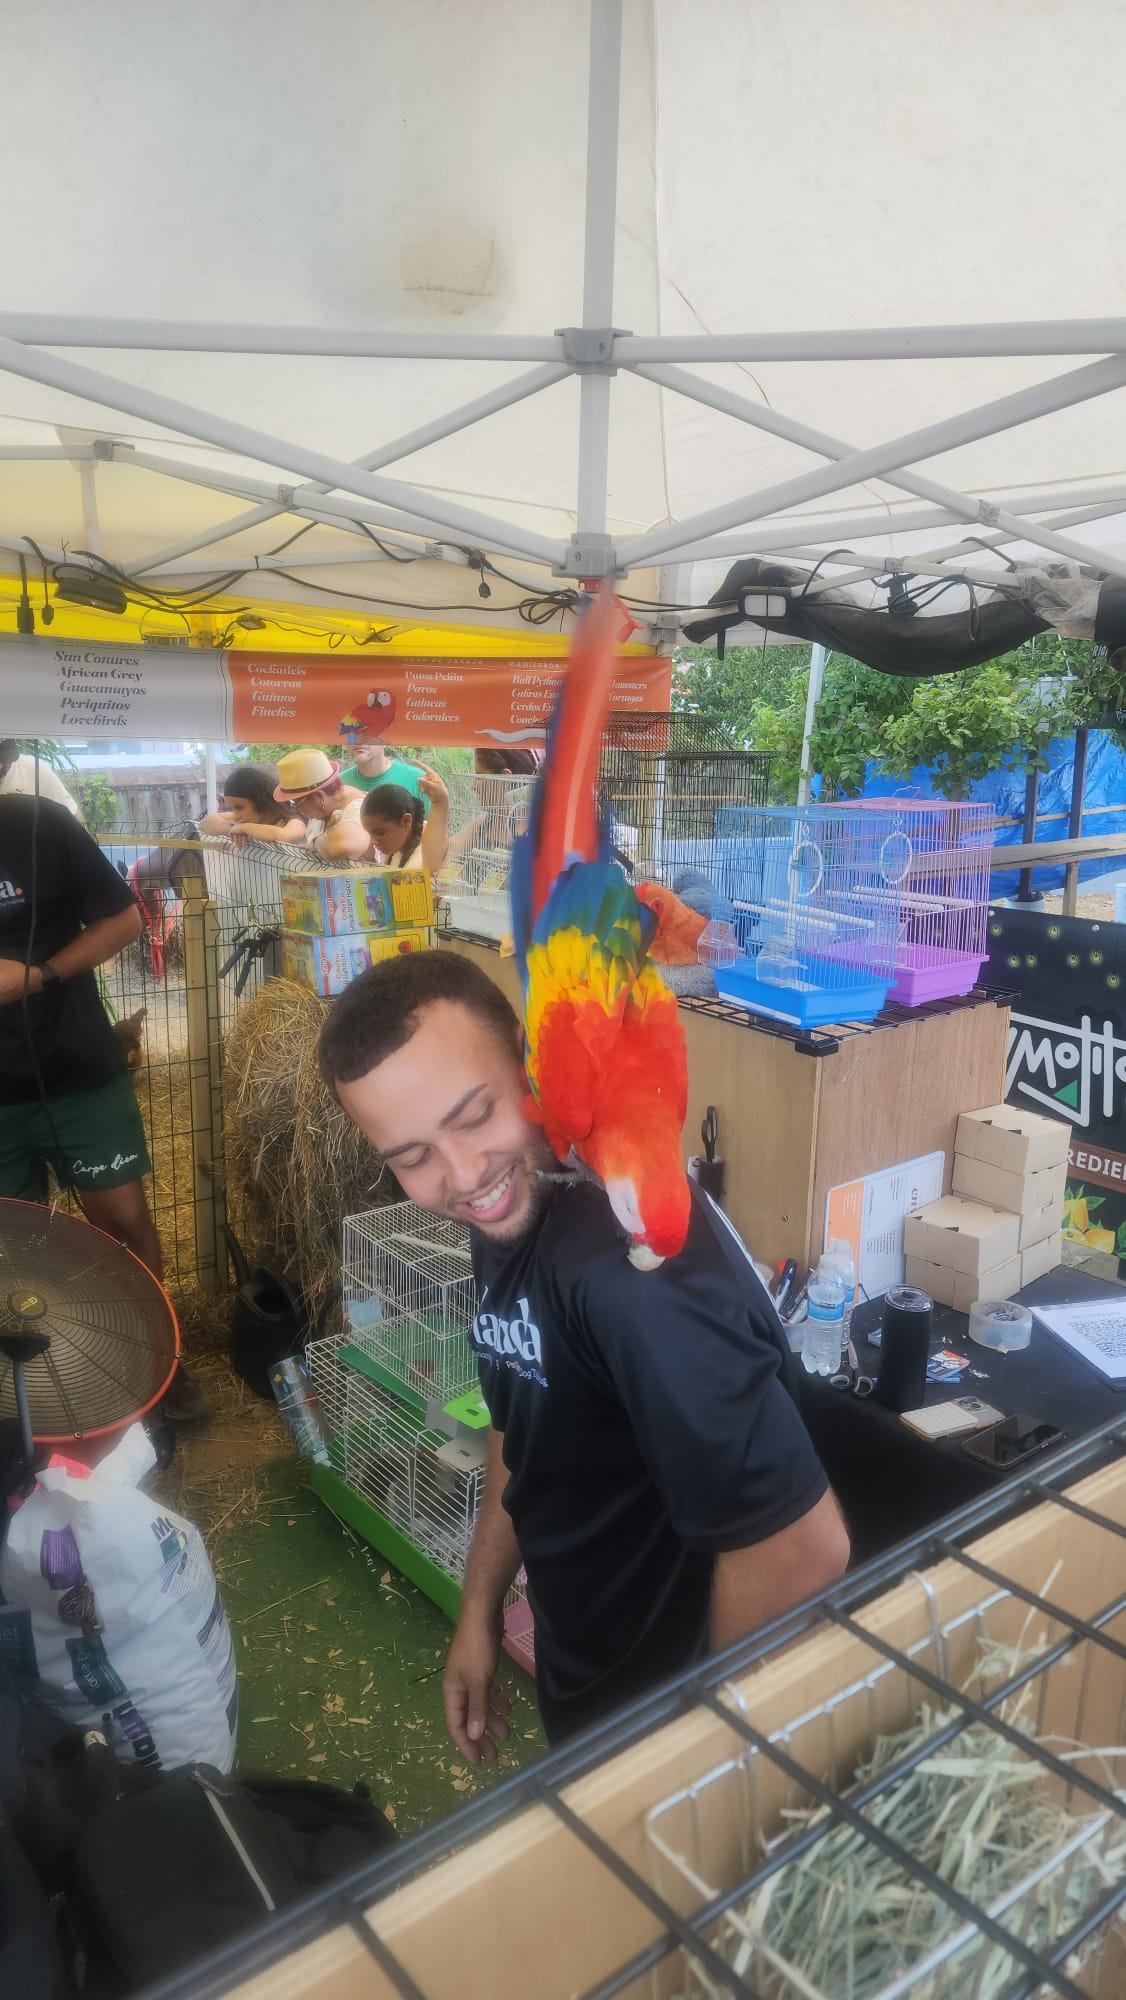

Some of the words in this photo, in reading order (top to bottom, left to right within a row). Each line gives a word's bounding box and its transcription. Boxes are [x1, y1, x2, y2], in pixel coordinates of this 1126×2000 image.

[55, 650, 81, 662] Sun
[84, 652, 140, 666] Conures
[57, 666, 108, 679] African
[110, 668, 143, 682] Grey
[247, 663, 307, 676] Cockatiels
[404, 670, 431, 680] Patos
[250, 676, 303, 688] Cotorras
[512, 675, 530, 685] Ball
[59, 681, 146, 698] Guacamayos
[406, 683, 438, 694] Pavos
[511, 688, 542, 698] Cabras
[406, 697, 447, 708] Guineas
[607, 692, 645, 704] Tortugas
[60, 697, 131, 713] Periquitos
[510, 701, 541, 712] Cerdos
[251, 705, 297, 718] Finches
[405, 711, 461, 722] Codornices
[60, 713, 128, 727] Lovebirds
[72, 1159, 108, 1178] Carpe
[110, 1153, 139, 1170] diem
[1066, 1149, 1126, 1180] REDIE
